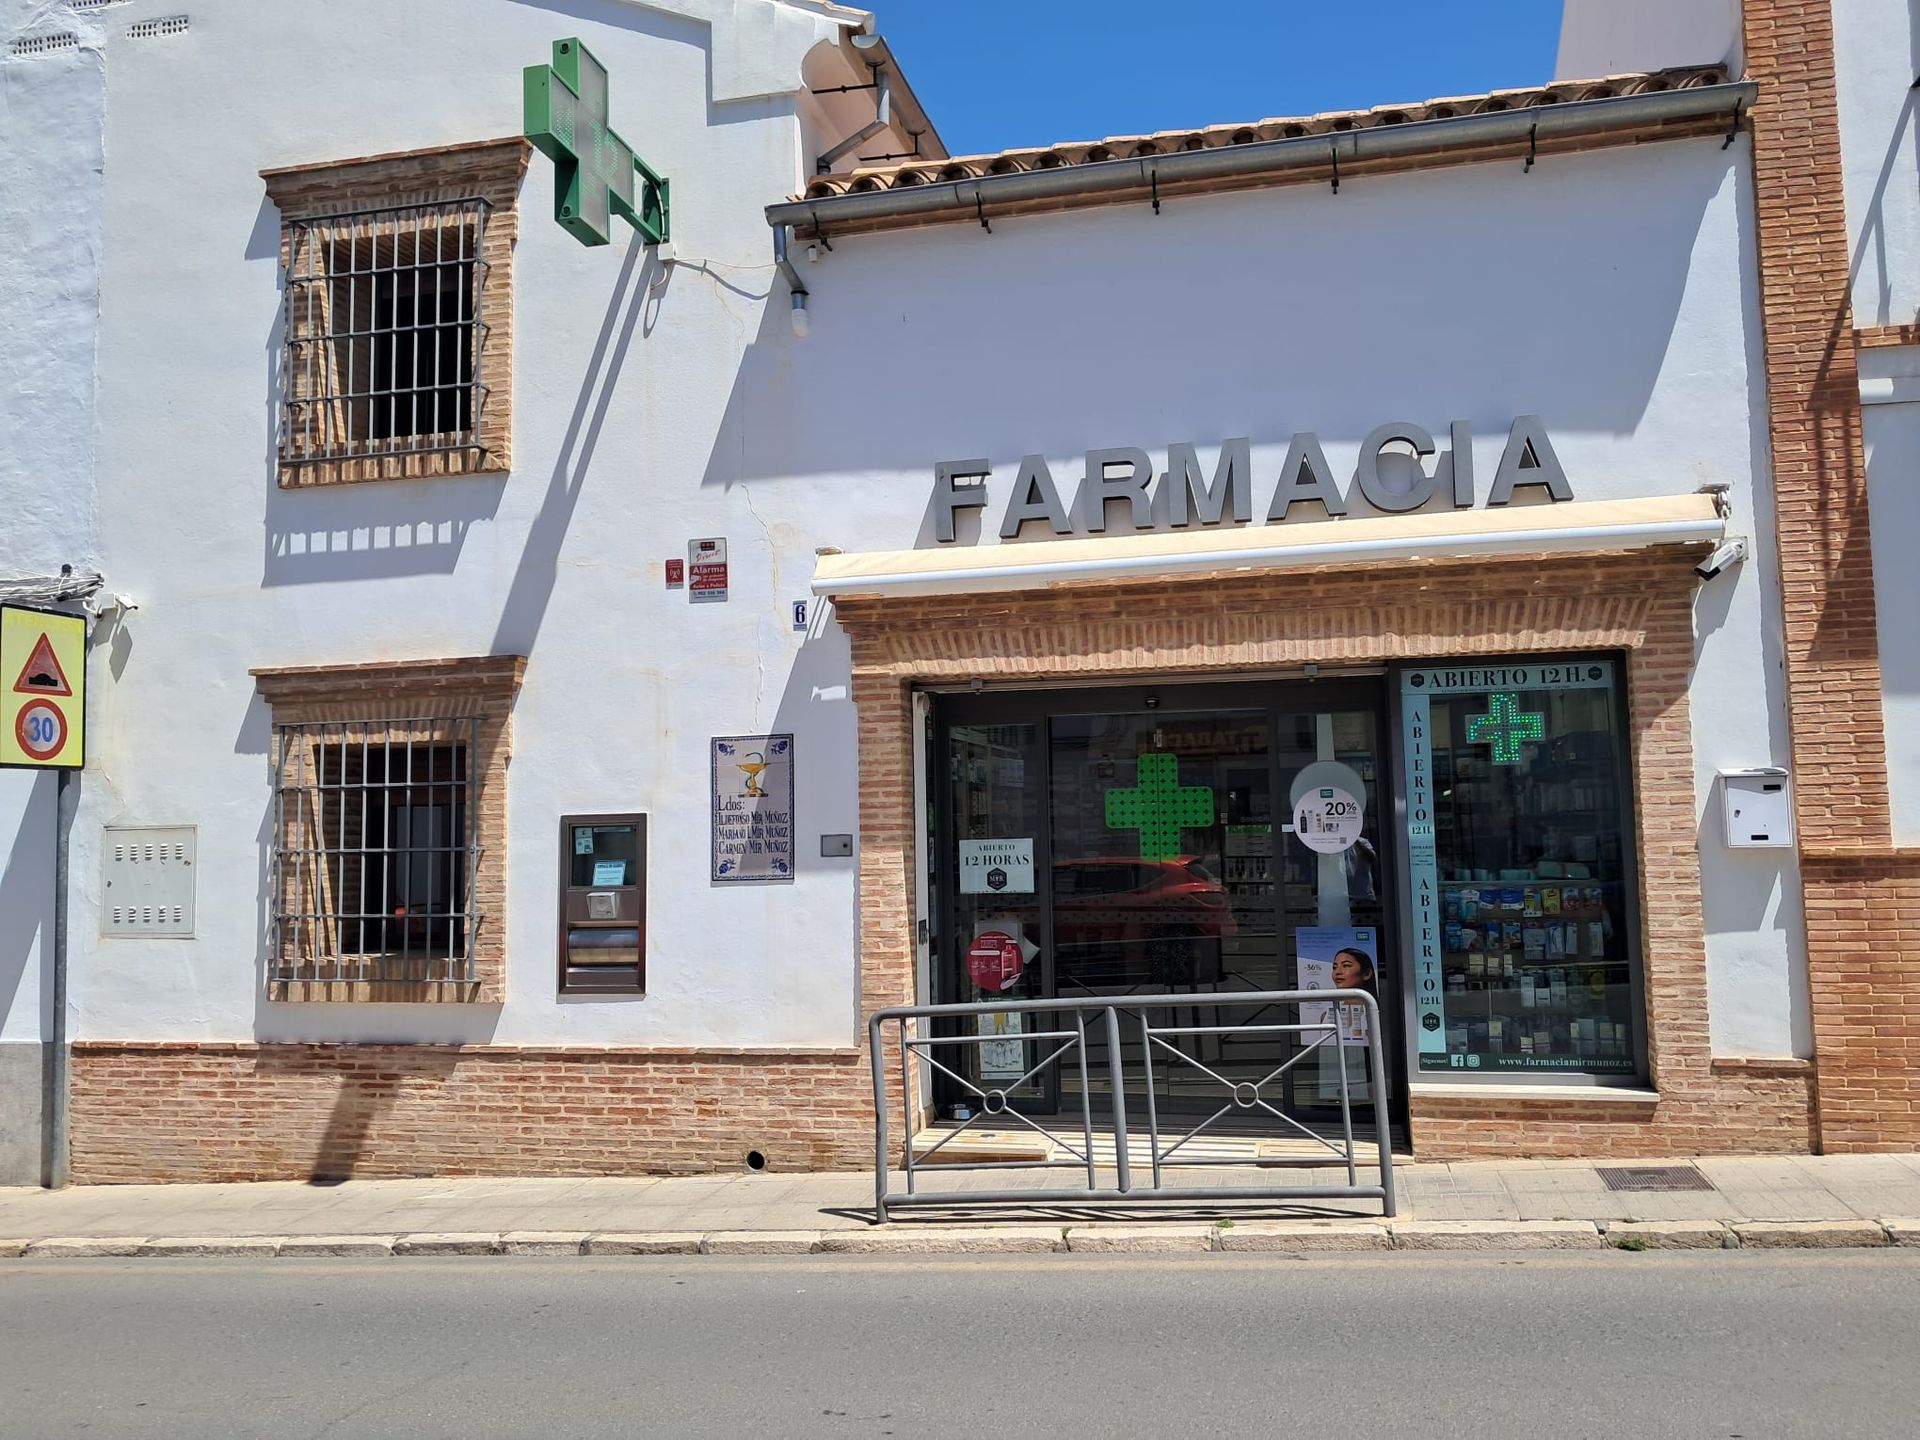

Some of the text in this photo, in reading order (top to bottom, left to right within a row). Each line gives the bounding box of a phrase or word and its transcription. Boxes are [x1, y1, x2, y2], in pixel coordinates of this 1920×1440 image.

[935, 413, 1575, 543] FARMACIA
[692, 566, 725, 574] Alarma
[796, 604, 805, 623] 6
[1428, 669, 1528, 688] ABIERTO
[1540, 668, 1561, 684] 12
[1565, 666, 1586, 683] H.
[30, 716, 54, 744] 30
[1411, 711, 1427, 822] ABIERTO
[718, 794, 746, 811] Ldos:
[1324, 802, 1357, 816] 20%
[979, 844, 1016, 852] ABIERTO
[965, 854, 1030, 866] 12 HORAS
[1419, 877, 1435, 992] ABIERTO
